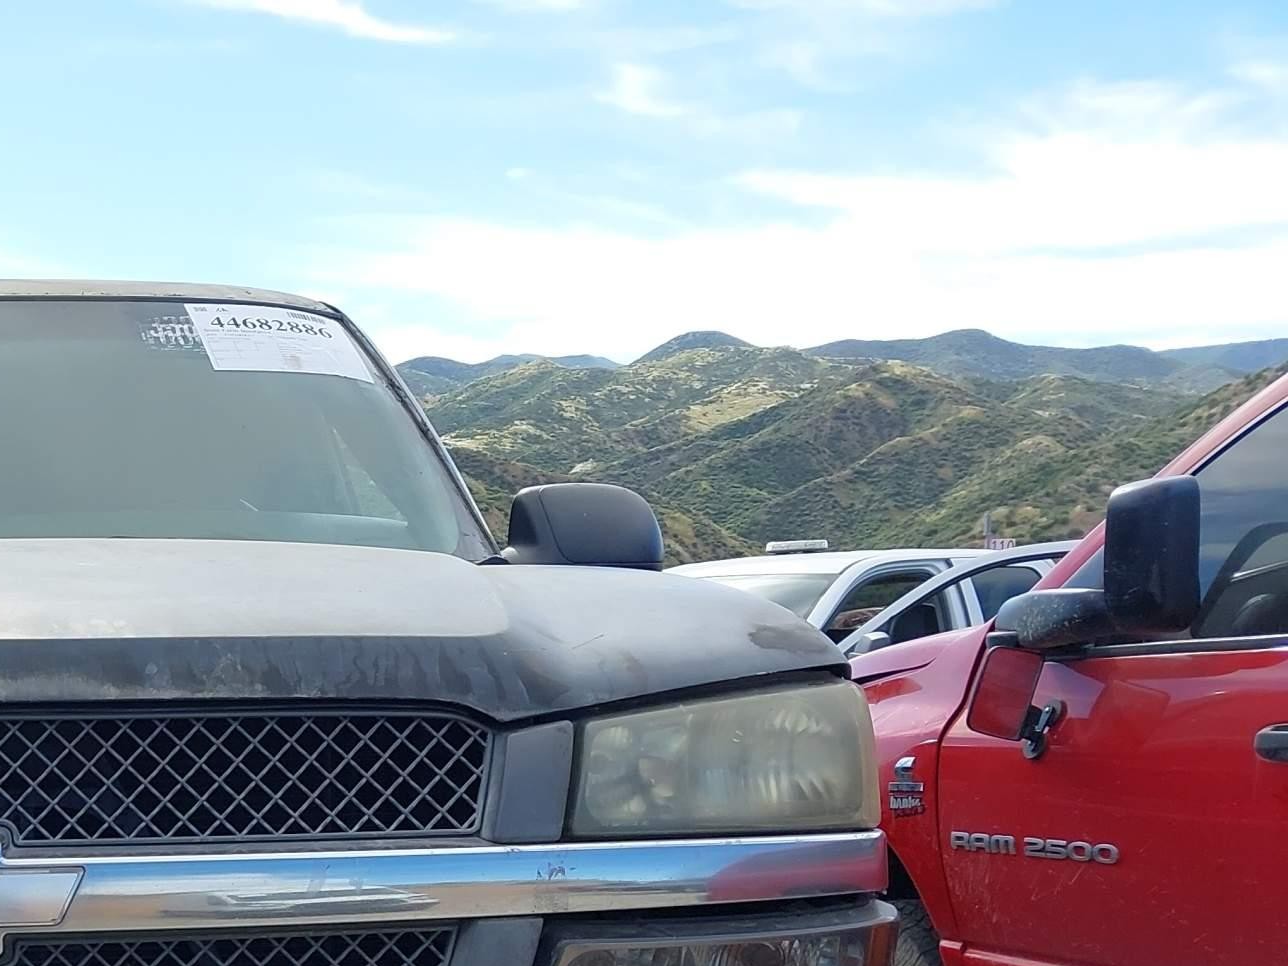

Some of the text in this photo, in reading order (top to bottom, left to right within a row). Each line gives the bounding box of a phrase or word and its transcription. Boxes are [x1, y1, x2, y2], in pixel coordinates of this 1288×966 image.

[210, 316, 333, 339] 44682886
[950, 831, 1119, 864] RAM 2500
